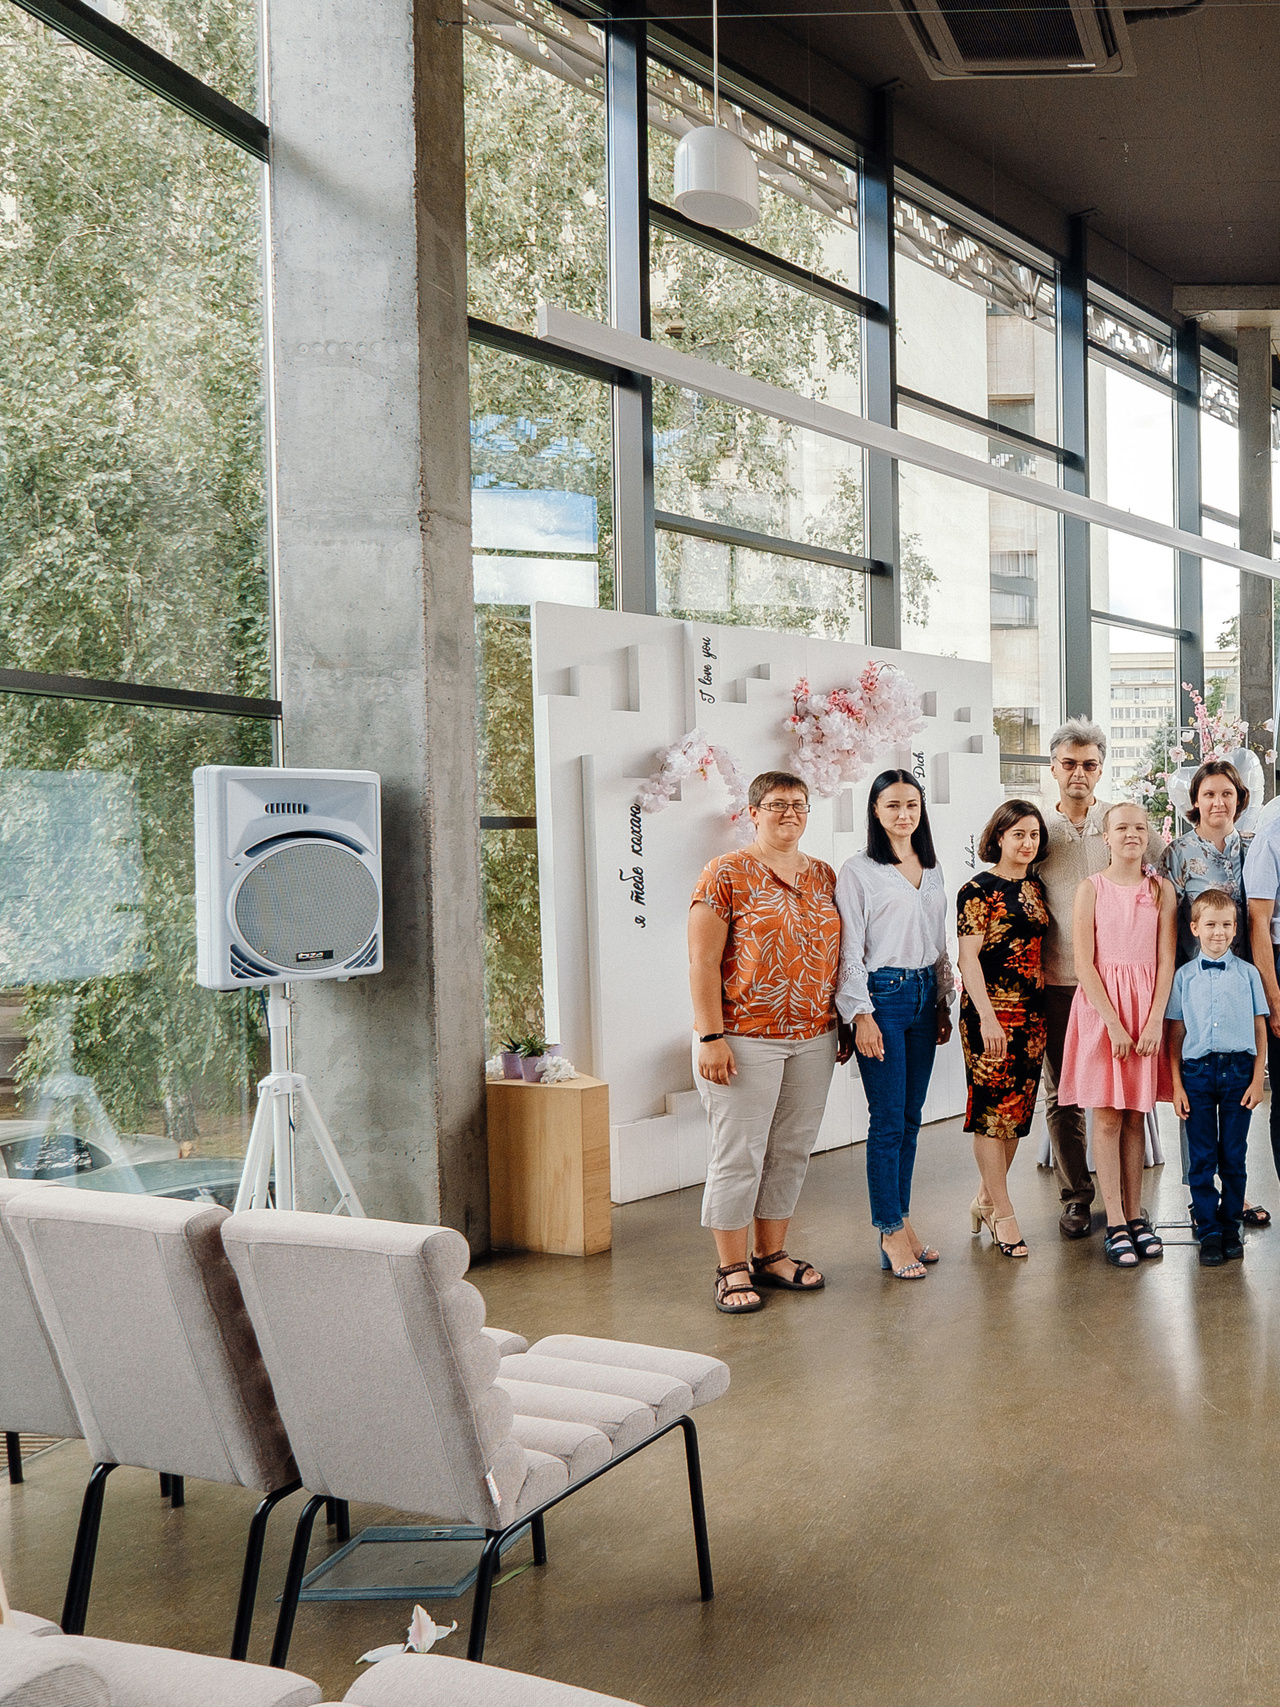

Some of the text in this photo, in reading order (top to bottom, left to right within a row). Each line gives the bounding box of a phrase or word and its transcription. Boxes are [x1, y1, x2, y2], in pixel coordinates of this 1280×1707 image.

[701, 636, 718, 660] you
[697, 663, 713, 686] love
[618, 802, 647, 929] я тебе кохаю
